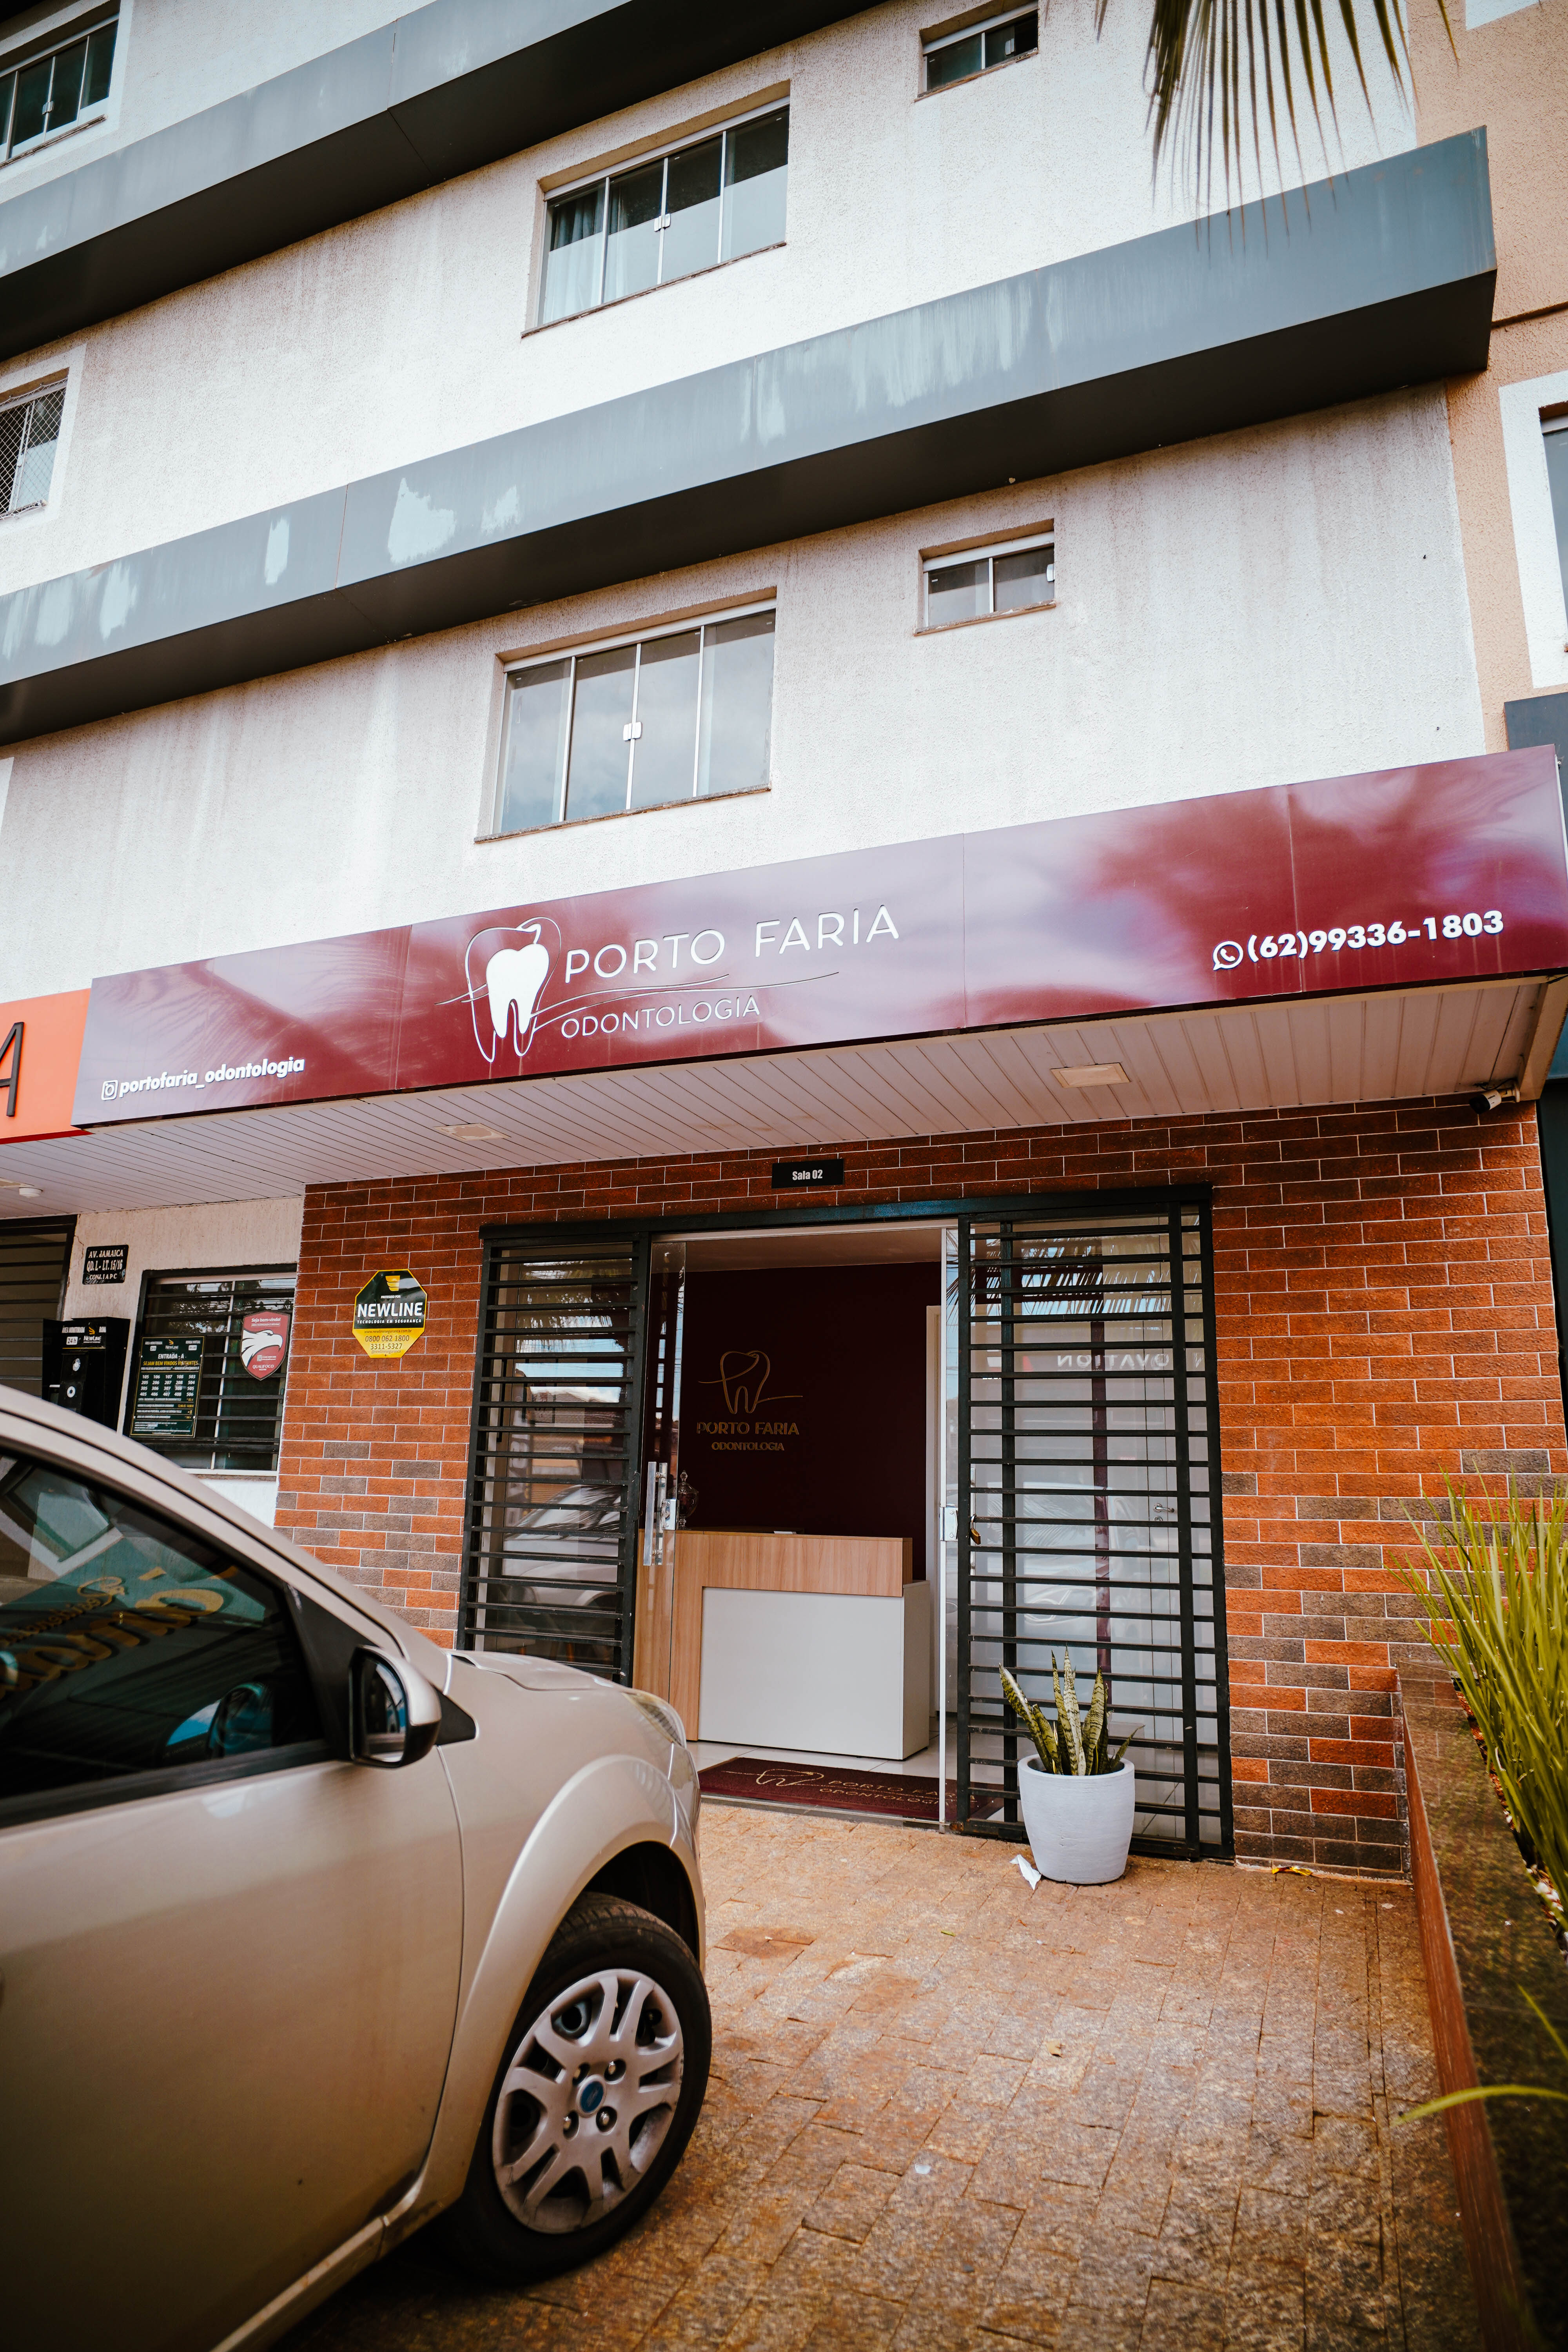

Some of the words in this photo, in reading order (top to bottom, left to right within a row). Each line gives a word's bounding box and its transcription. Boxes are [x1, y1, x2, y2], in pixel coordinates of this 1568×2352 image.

[1247, 909, 1504, 963] (62)99336-1803
[564, 928, 725, 984] PORTO
[755, 904, 900, 958] FARIA
[561, 995, 760, 1038] ODONTOLOGIA
[118, 1056, 305, 1098] portofaria_odontologia
[792, 1170, 811, 1181] Sala
[812, 1169, 823, 1179] 02
[99, 1249, 123, 1258] JAMAICA
[95, 1260, 98, 1271] L
[110, 1259, 123, 1271] 15/16
[357, 1302, 423, 1318] NEWLINE
[697, 1421, 750, 1435] PORTO
[755, 1421, 800, 1435] FARIA
[711, 1442, 785, 1451] ODONTOLOGIA
